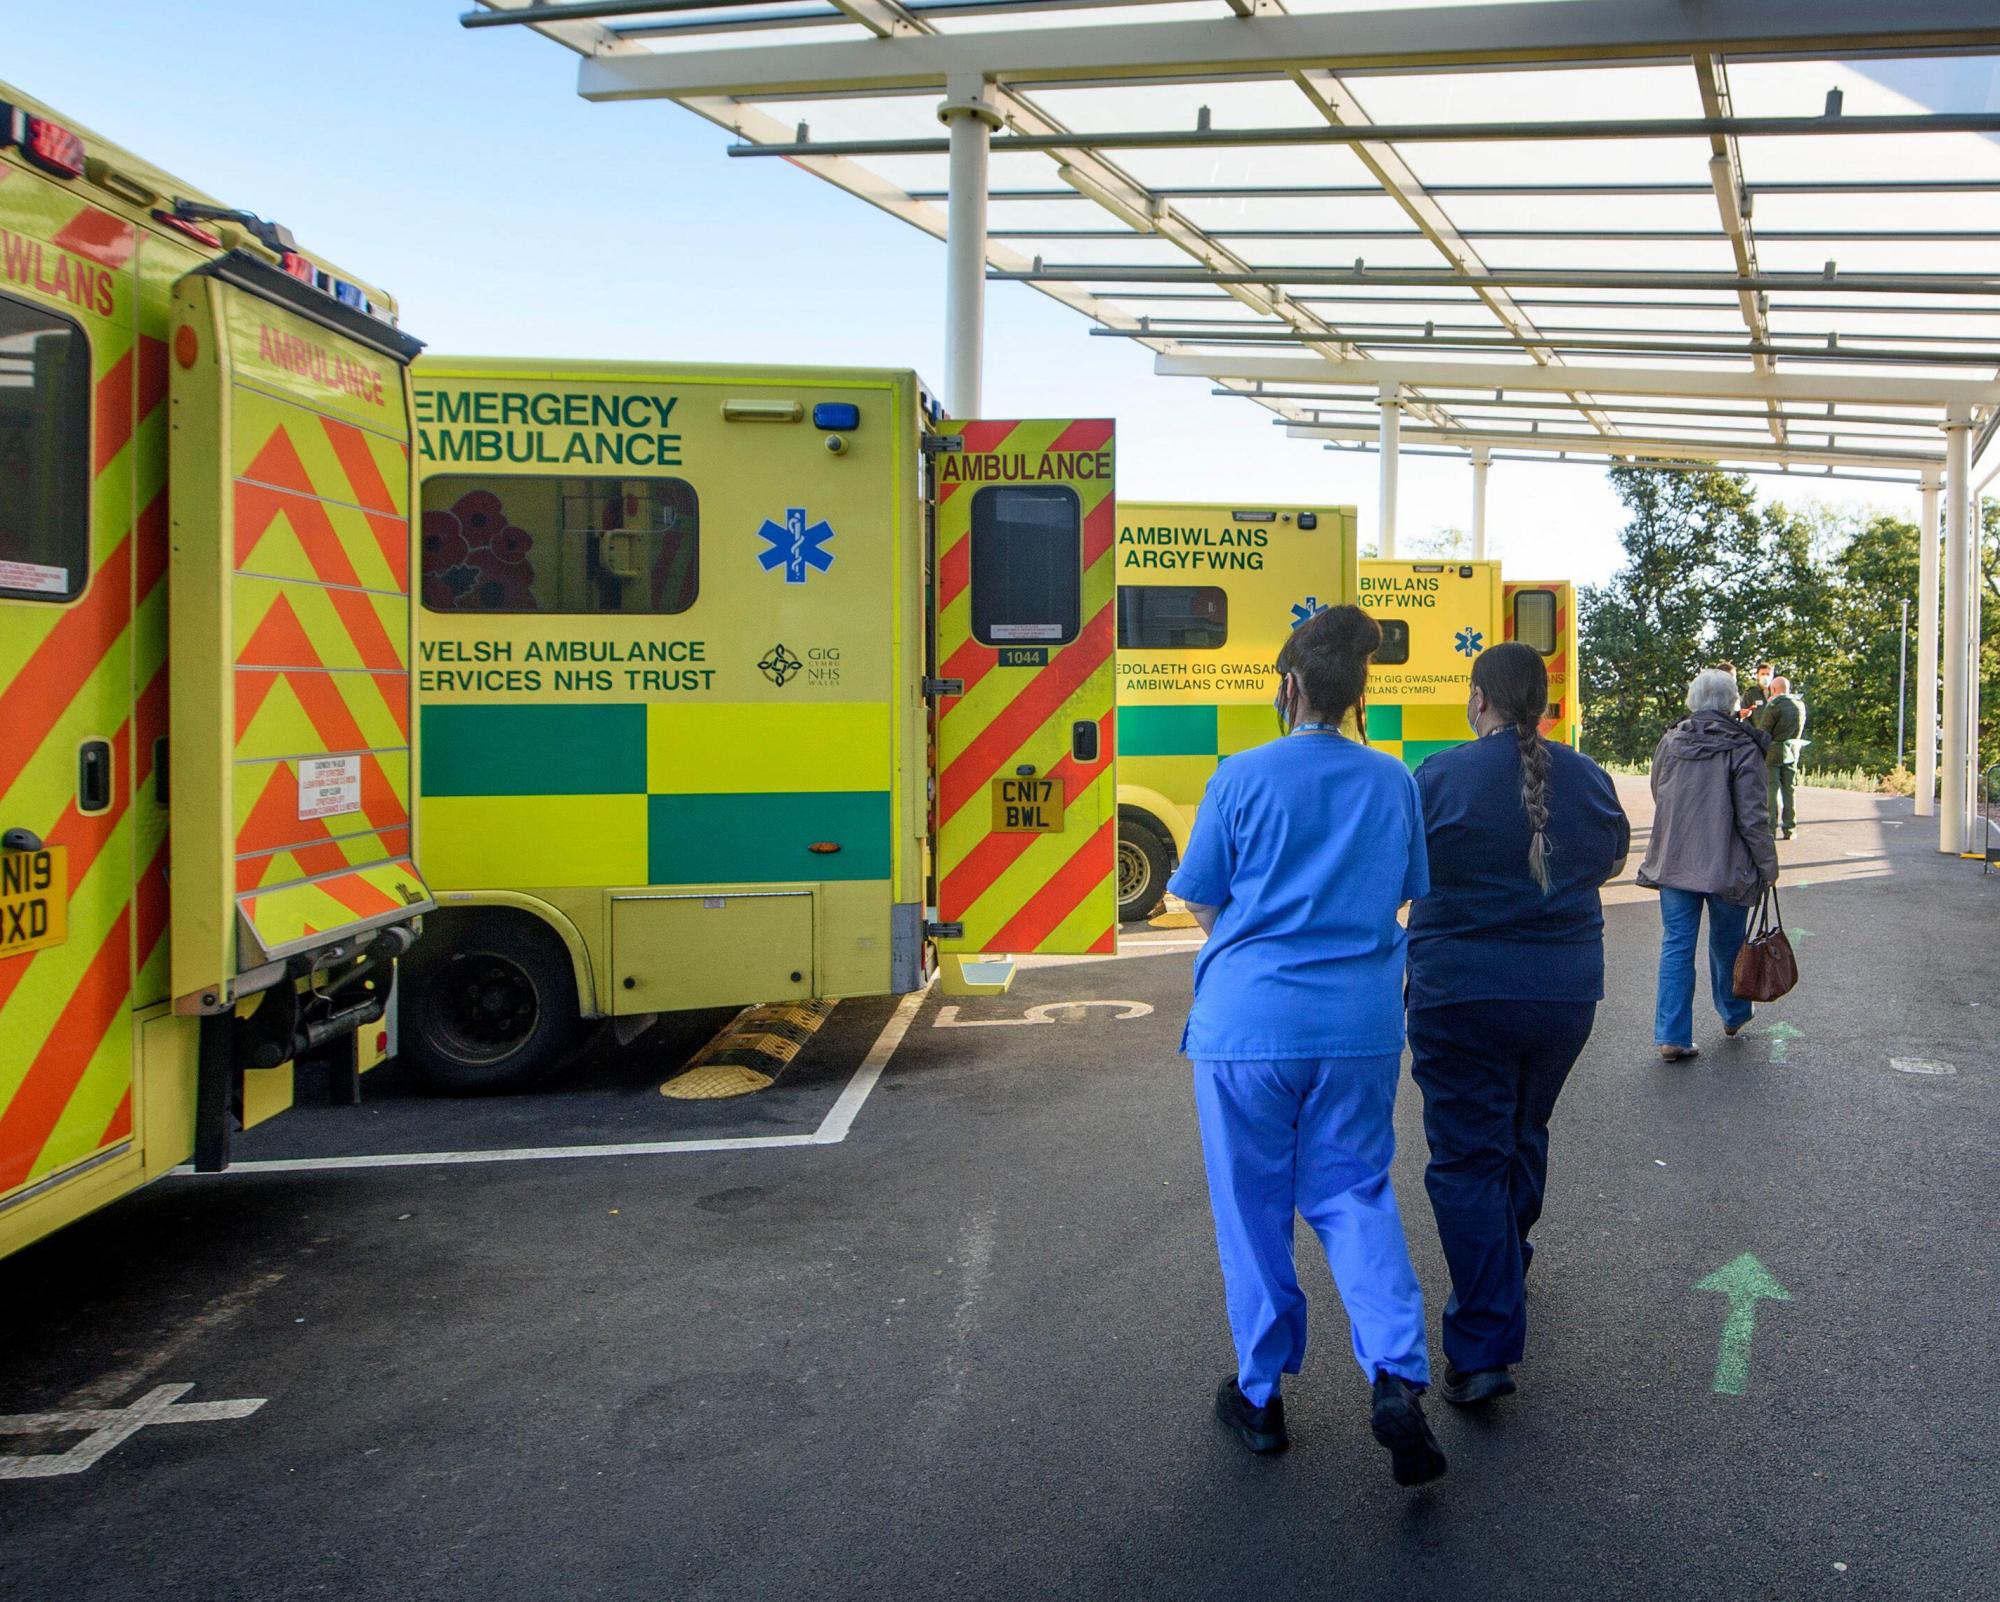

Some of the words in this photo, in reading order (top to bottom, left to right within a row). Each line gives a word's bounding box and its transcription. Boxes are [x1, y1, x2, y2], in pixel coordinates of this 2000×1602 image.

[259, 323, 385, 407] AMBULANCE
[414, 391, 679, 428] EMERGENCY
[418, 429, 683, 466] AMBULANCE
[942, 452, 1112, 481] AMBULANCE
[1119, 526, 1269, 547] AMBIWLANS
[1124, 550, 1264, 570] ARGYFWNG
[1360, 577, 1439, 591] BIWLANS
[1358, 594, 1436, 607] GYFWNG
[524, 641, 705, 662] AMBULANCE
[808, 648, 840, 660] GIG
[1007, 651, 1040, 664] 1044
[808, 668, 840, 680] NHS
[1192, 664, 1216, 675] GIG
[554, 670, 613, 691] NHS
[625, 670, 717, 691] TRUST
[1126, 679, 1211, 690] AMBIWLANS
[1215, 679, 1264, 690] CYMRU
[1401, 686, 1436, 695] CYMRU
[1003, 781, 1053, 802] CN17
[1006, 806, 1050, 827] BWL
[3, 850, 51, 896] N19
[0, 898, 47, 945] XD
